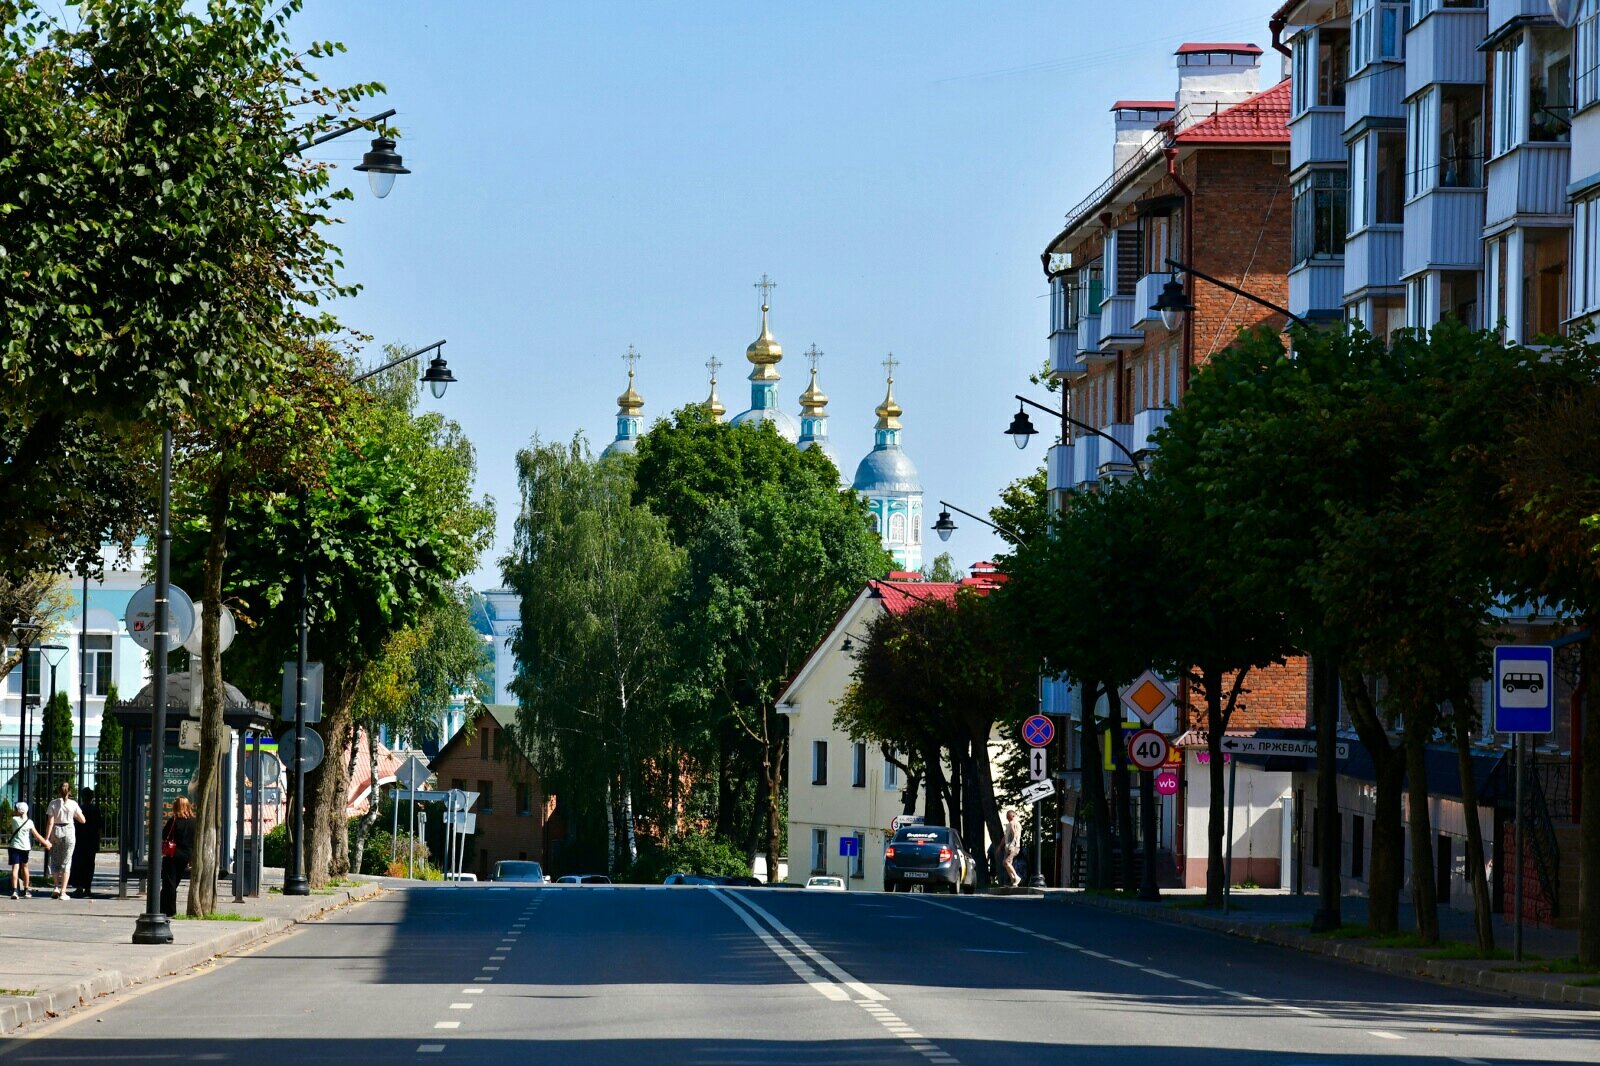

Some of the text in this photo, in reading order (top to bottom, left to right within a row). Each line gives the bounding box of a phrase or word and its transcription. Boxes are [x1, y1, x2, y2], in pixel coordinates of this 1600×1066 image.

[1137, 741, 1160, 758] 40
[1242, 741, 1346, 756] ул. ПРЖЕВАЛЬСО
[1158, 778, 1176, 789] wb
